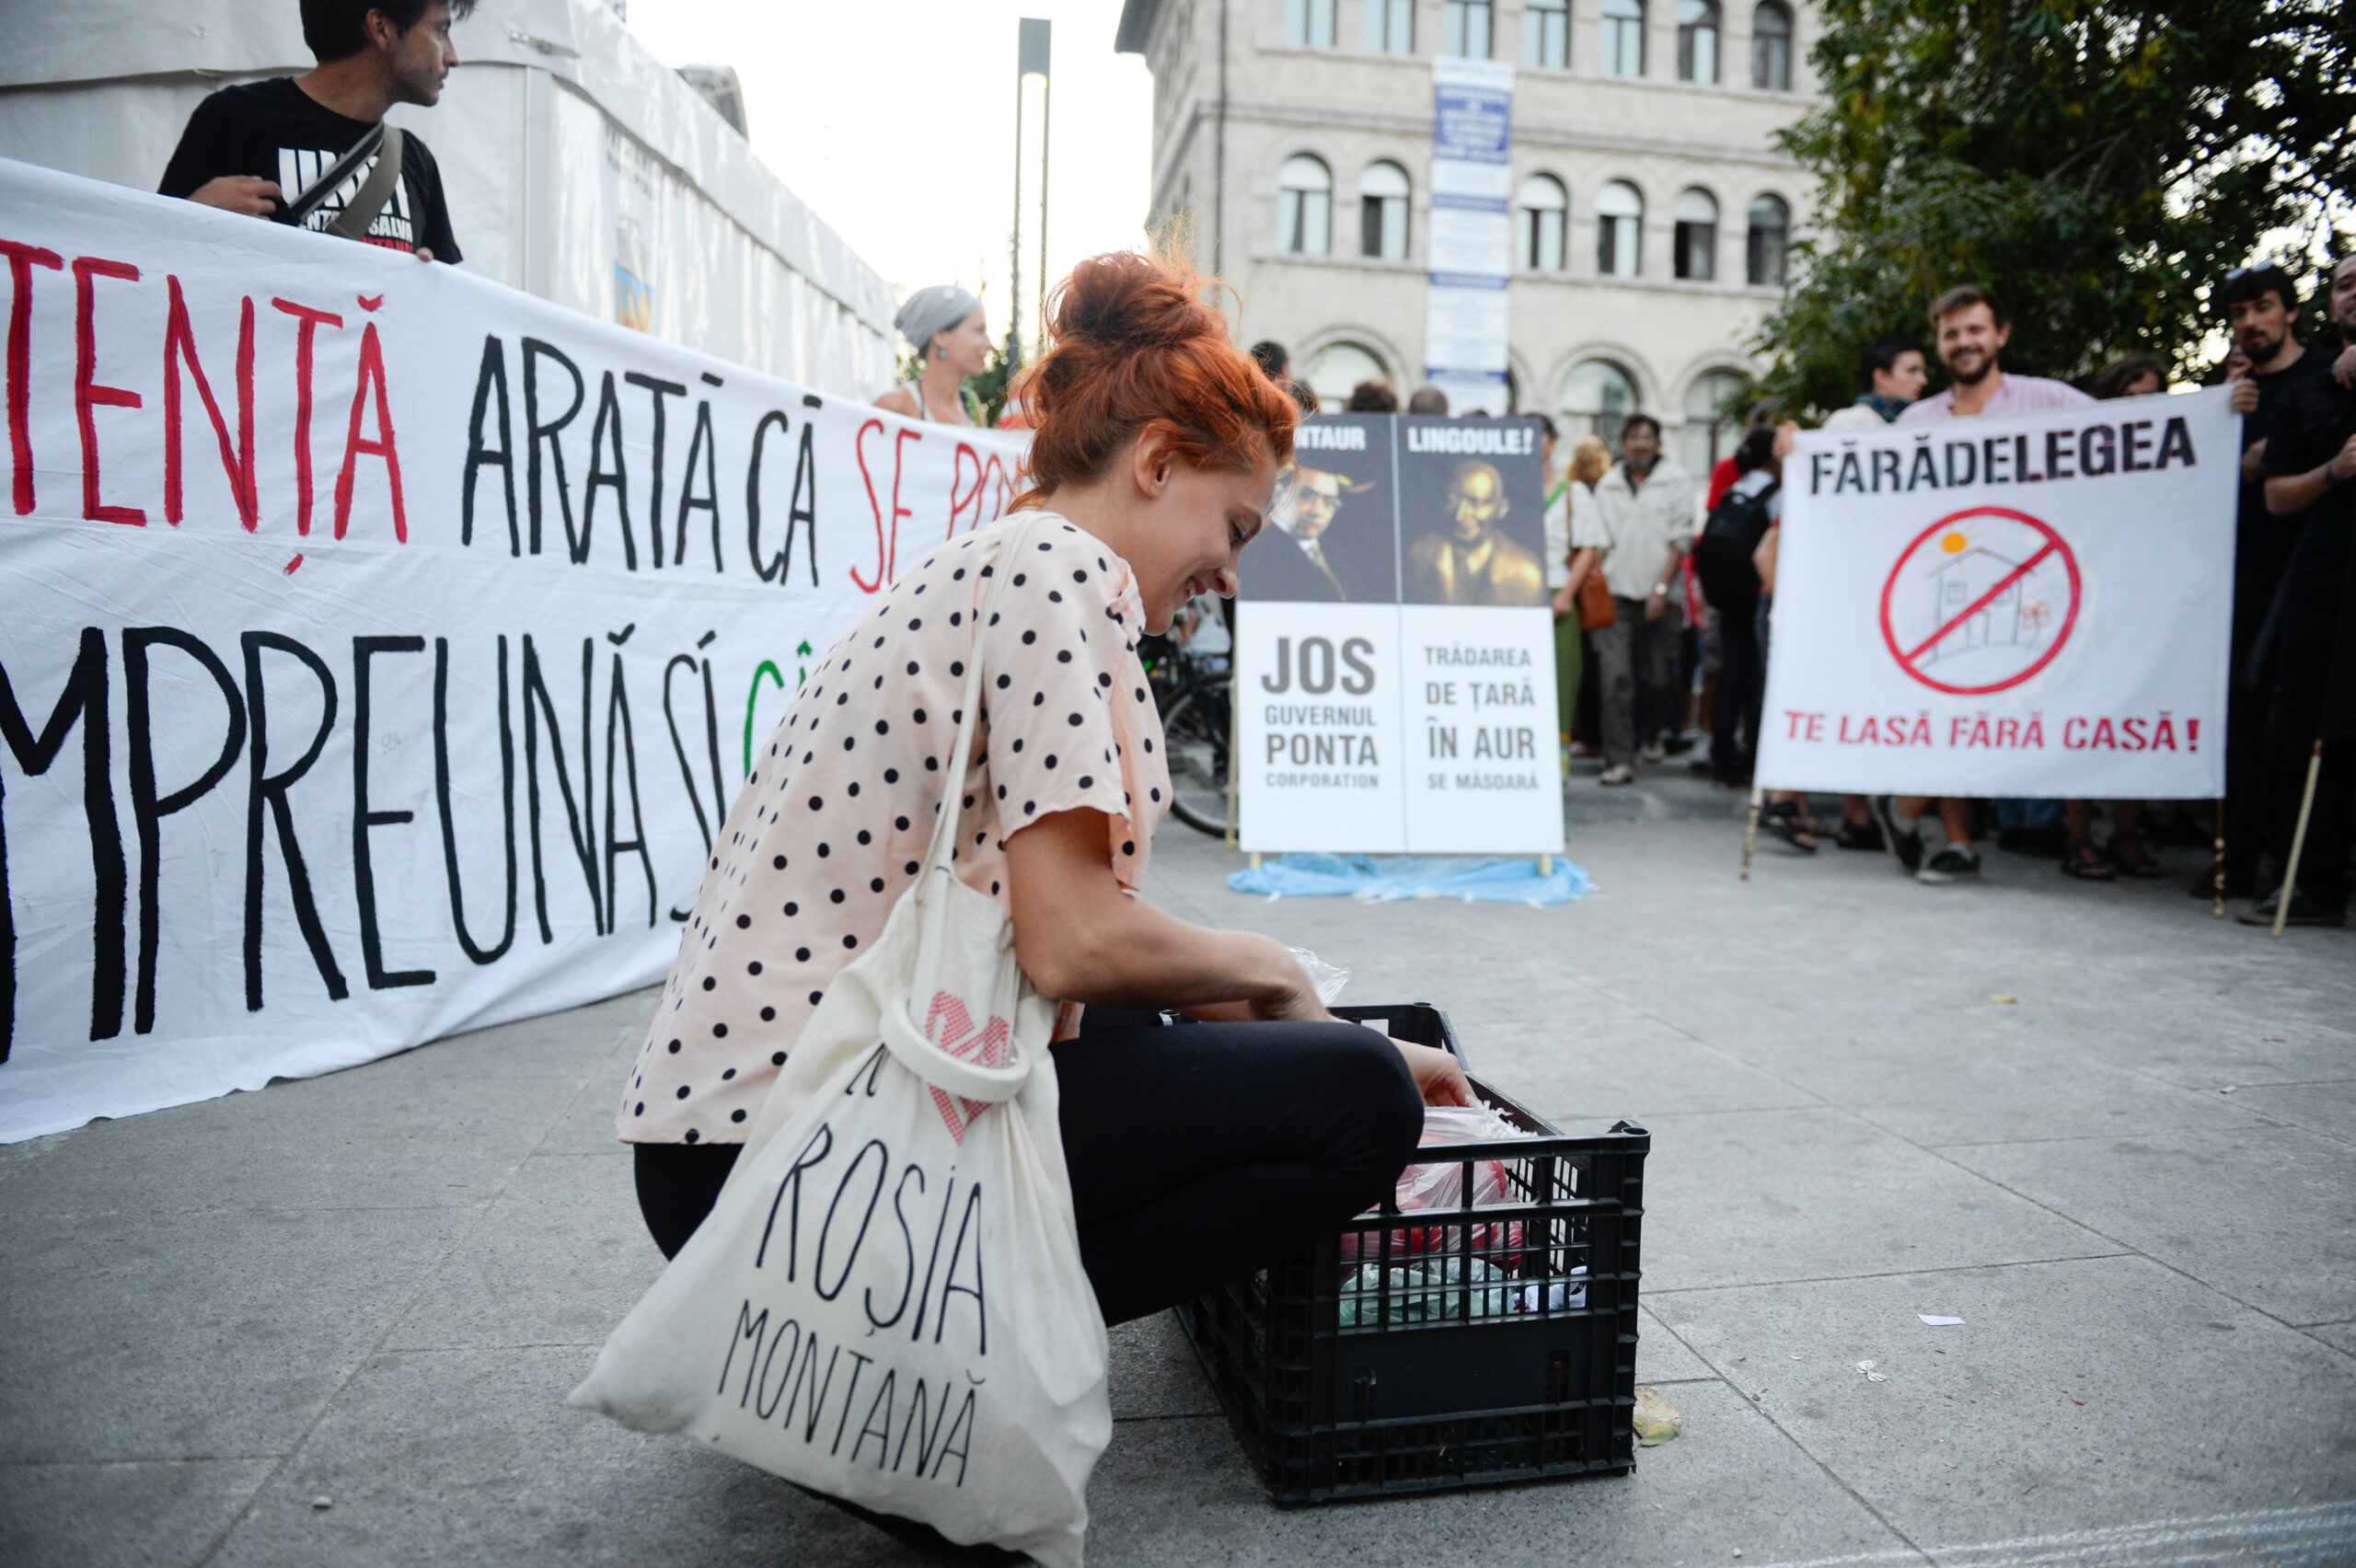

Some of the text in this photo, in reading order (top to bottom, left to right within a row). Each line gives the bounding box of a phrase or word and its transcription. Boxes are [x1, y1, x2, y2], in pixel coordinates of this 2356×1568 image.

[1407, 426, 1534, 455] LINGOULE!
[1810, 416, 2198, 495] FĂRĂDELEGEA
[1261, 637, 1375, 696] JOS
[1425, 642, 1531, 666] TRĂDAREA
[1426, 682, 1457, 705] DE
[1265, 705, 1377, 726] GUVERNUL
[1784, 711, 1824, 742] TE
[1839, 711, 1933, 747] LASĂ
[1949, 711, 2045, 749] FĂRĂ
[1266, 733, 1379, 766] PONTA
[1426, 716, 1535, 759] ÎN AUR
[1265, 773, 1380, 789] CORPORATION
[1427, 773, 1448, 790] SE
